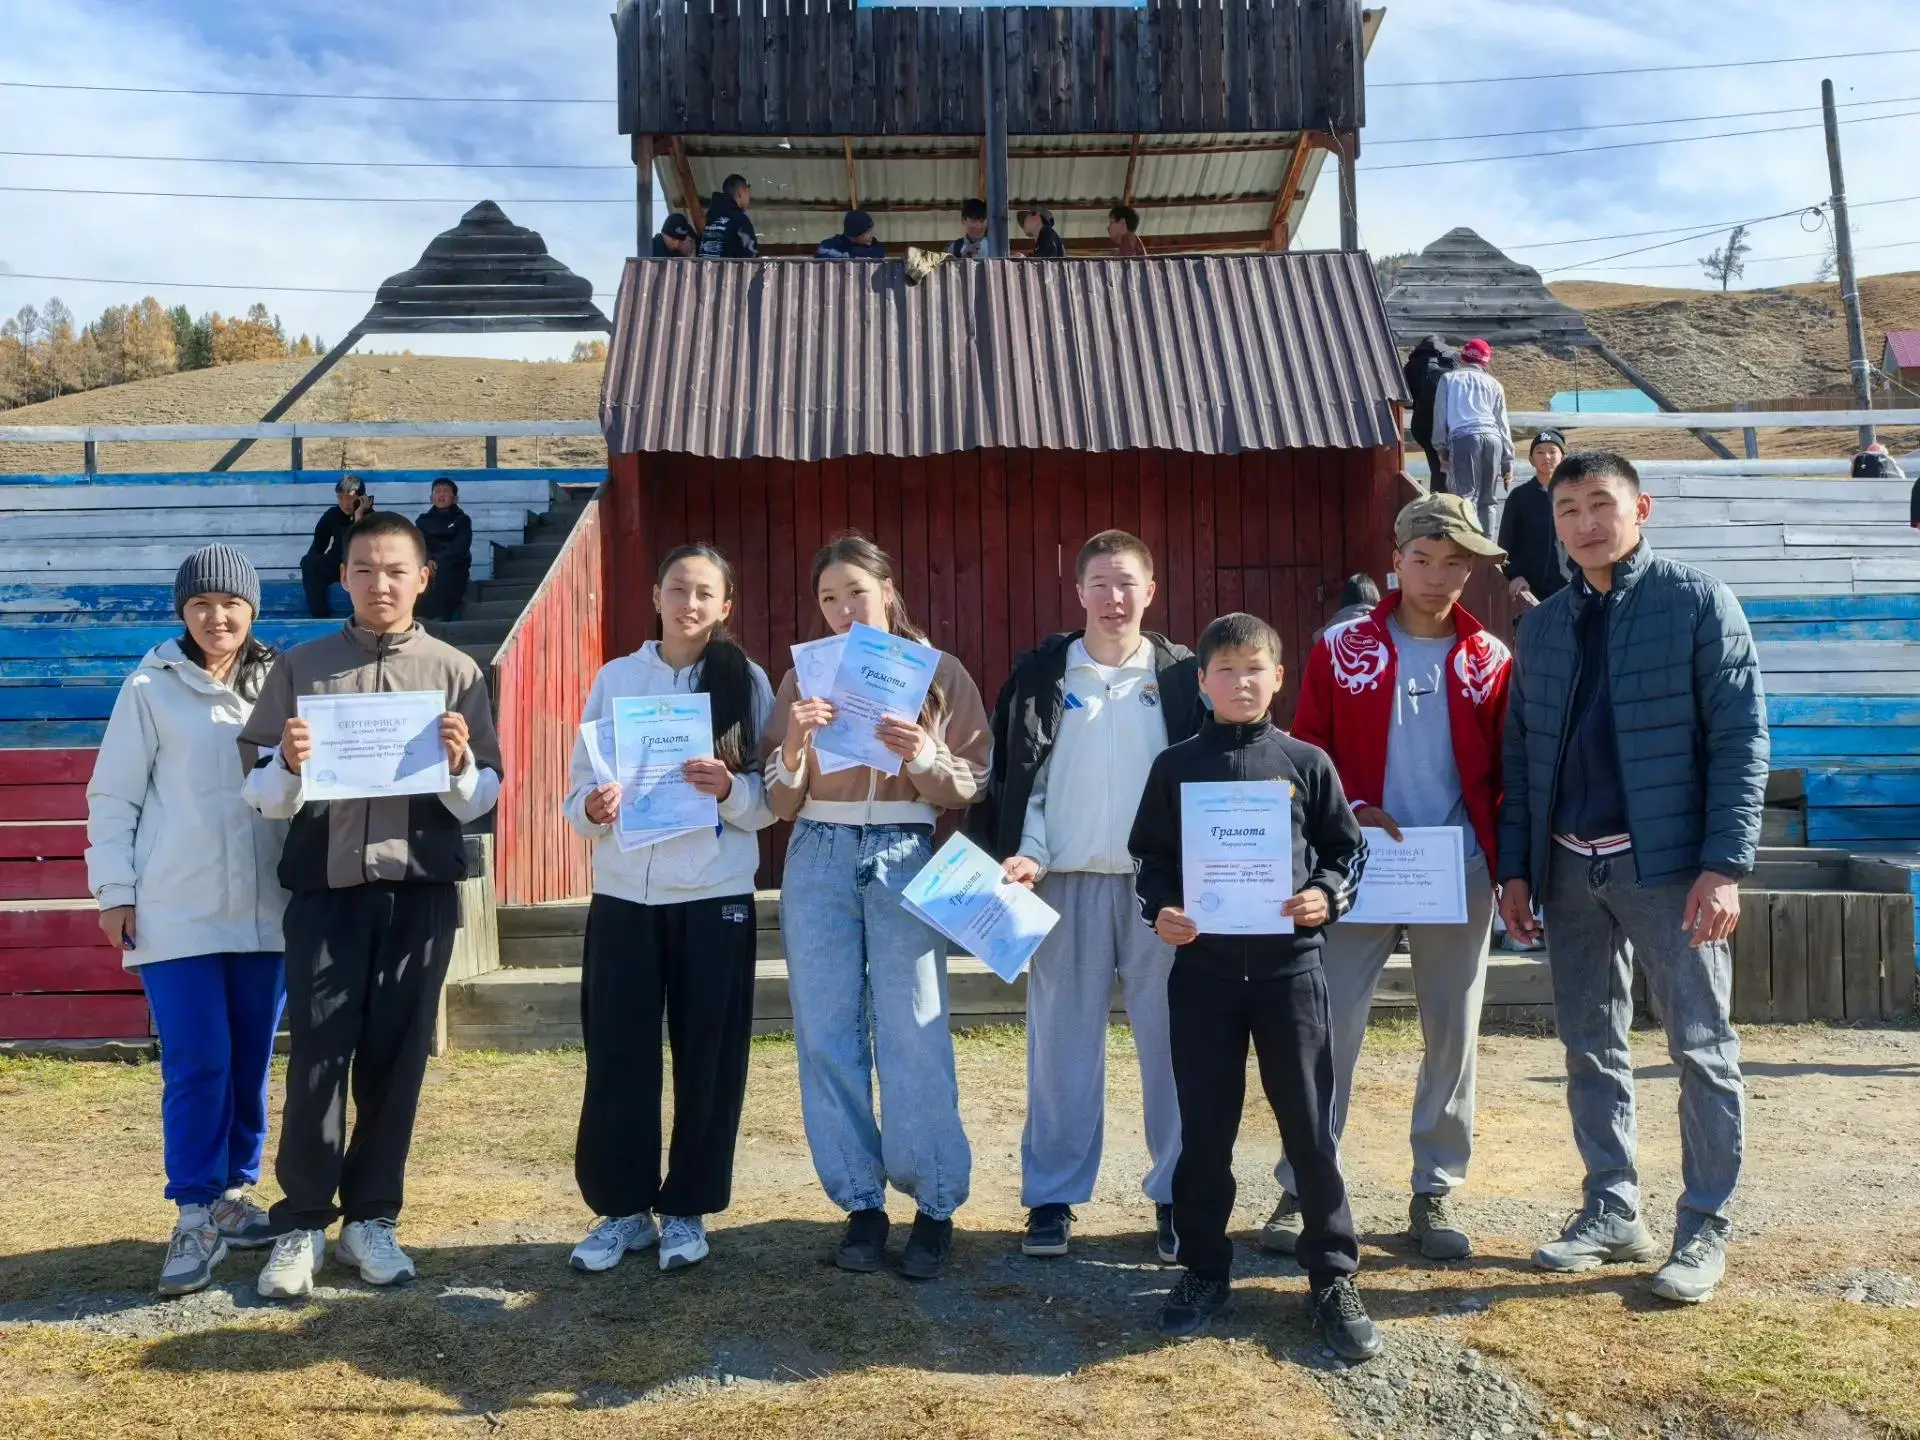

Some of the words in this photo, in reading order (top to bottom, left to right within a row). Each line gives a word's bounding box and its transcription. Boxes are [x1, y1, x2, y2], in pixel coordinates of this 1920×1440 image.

[861, 665, 906, 688] Грамота
[337, 718, 408, 730] СЕРТИФИКАТ
[640, 735, 689, 748] Грамота
[1210, 826, 1266, 840] Грамота
[1368, 847, 1425, 857] ЕРТИФИКАТ
[949, 871, 982, 906] Грамота
